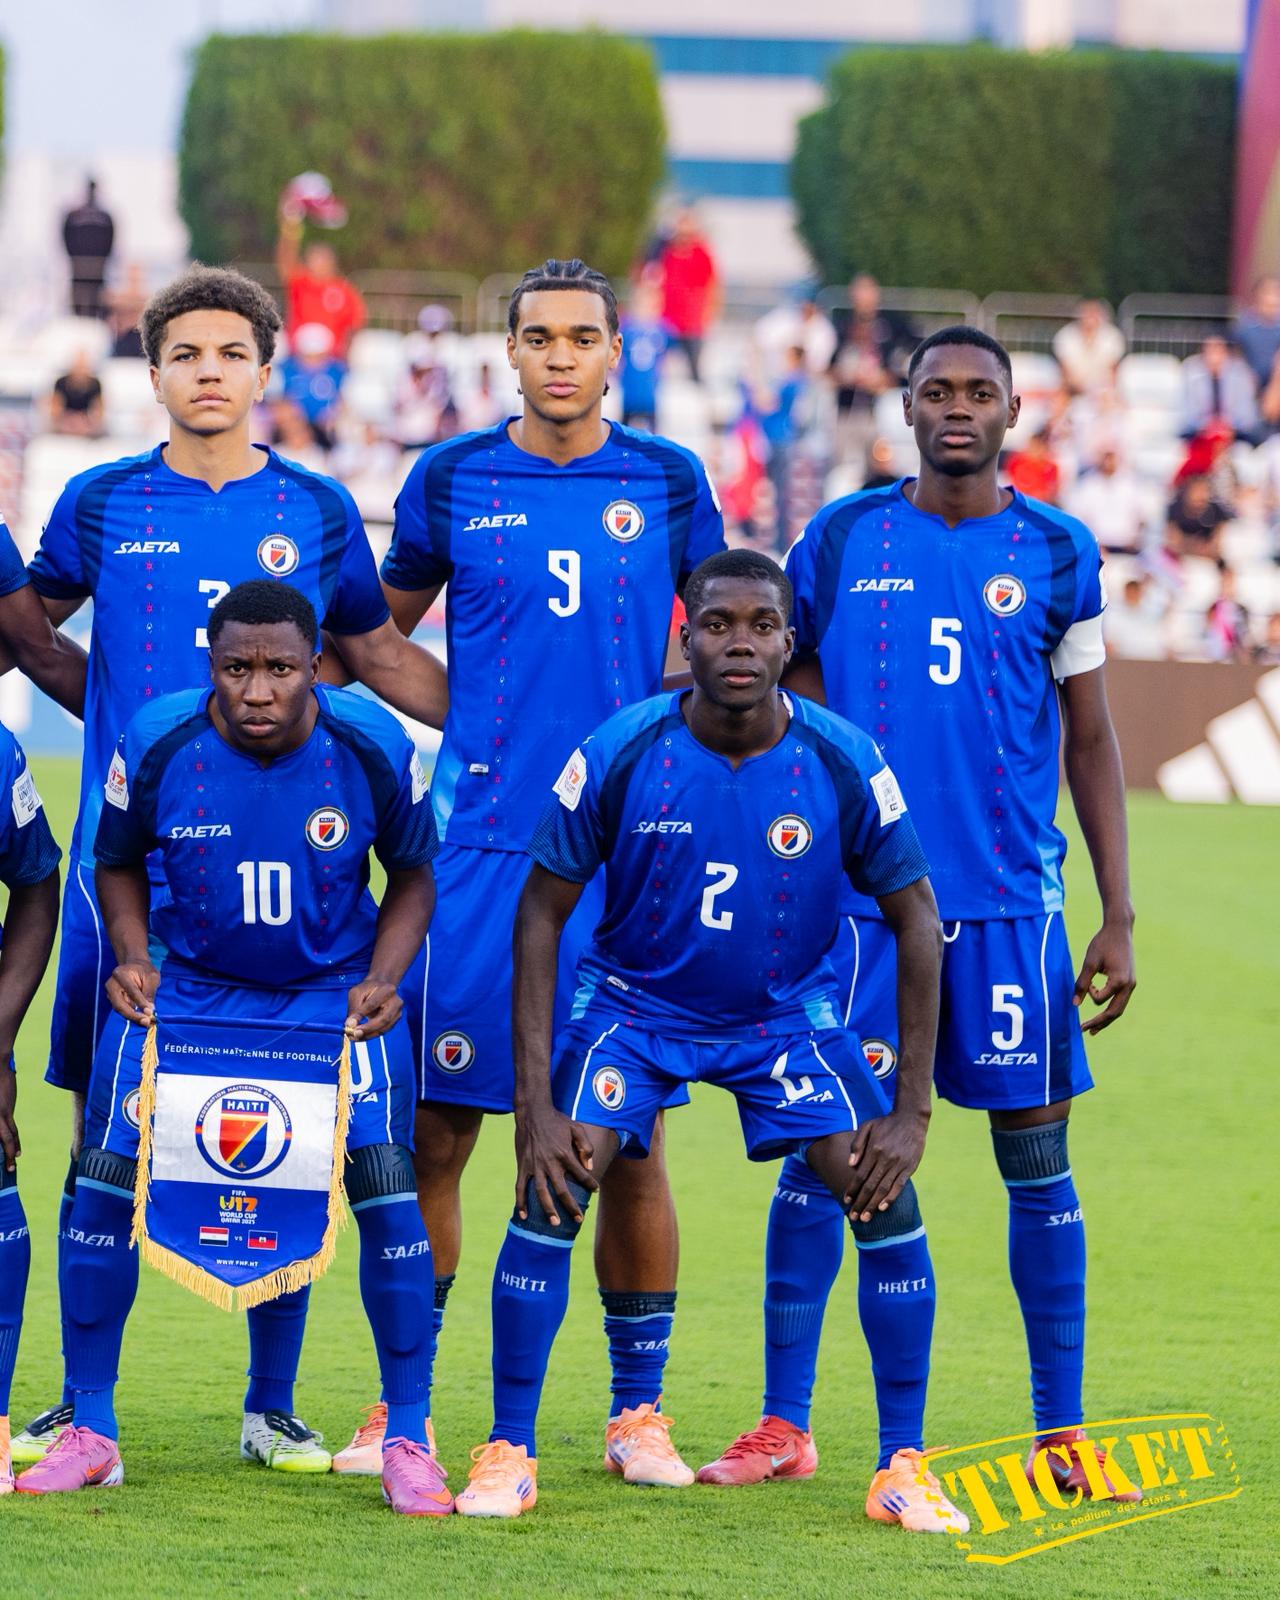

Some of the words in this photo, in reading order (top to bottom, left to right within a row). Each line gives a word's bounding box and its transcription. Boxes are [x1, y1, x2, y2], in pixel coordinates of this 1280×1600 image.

[463, 513, 527, 532] SAETA
[113, 541, 180, 554] SAETA
[548, 550, 580, 617] 9
[849, 578, 914, 593] SAETA
[928, 617, 963, 686] 5
[168, 824, 232, 839] SAETA
[630, 821, 692, 835] SAETA
[236, 861, 292, 926] 10
[700, 861, 739, 931] 2
[991, 984, 1024, 1050] 5
[272, 1051, 284, 1060] DE
[286, 1052, 333, 1063] FOOTBALL
[973, 1053, 1038, 1065] SAETA
[227, 1101, 264, 1112] HAITI
[220, 1196, 257, 1212] U17
[67, 1227, 115, 1247] SAETA
[380, 1240, 430, 1259] SAETA
[501, 1271, 546, 1293] HAÏTI
[878, 1278, 927, 1294] HAÏTI
